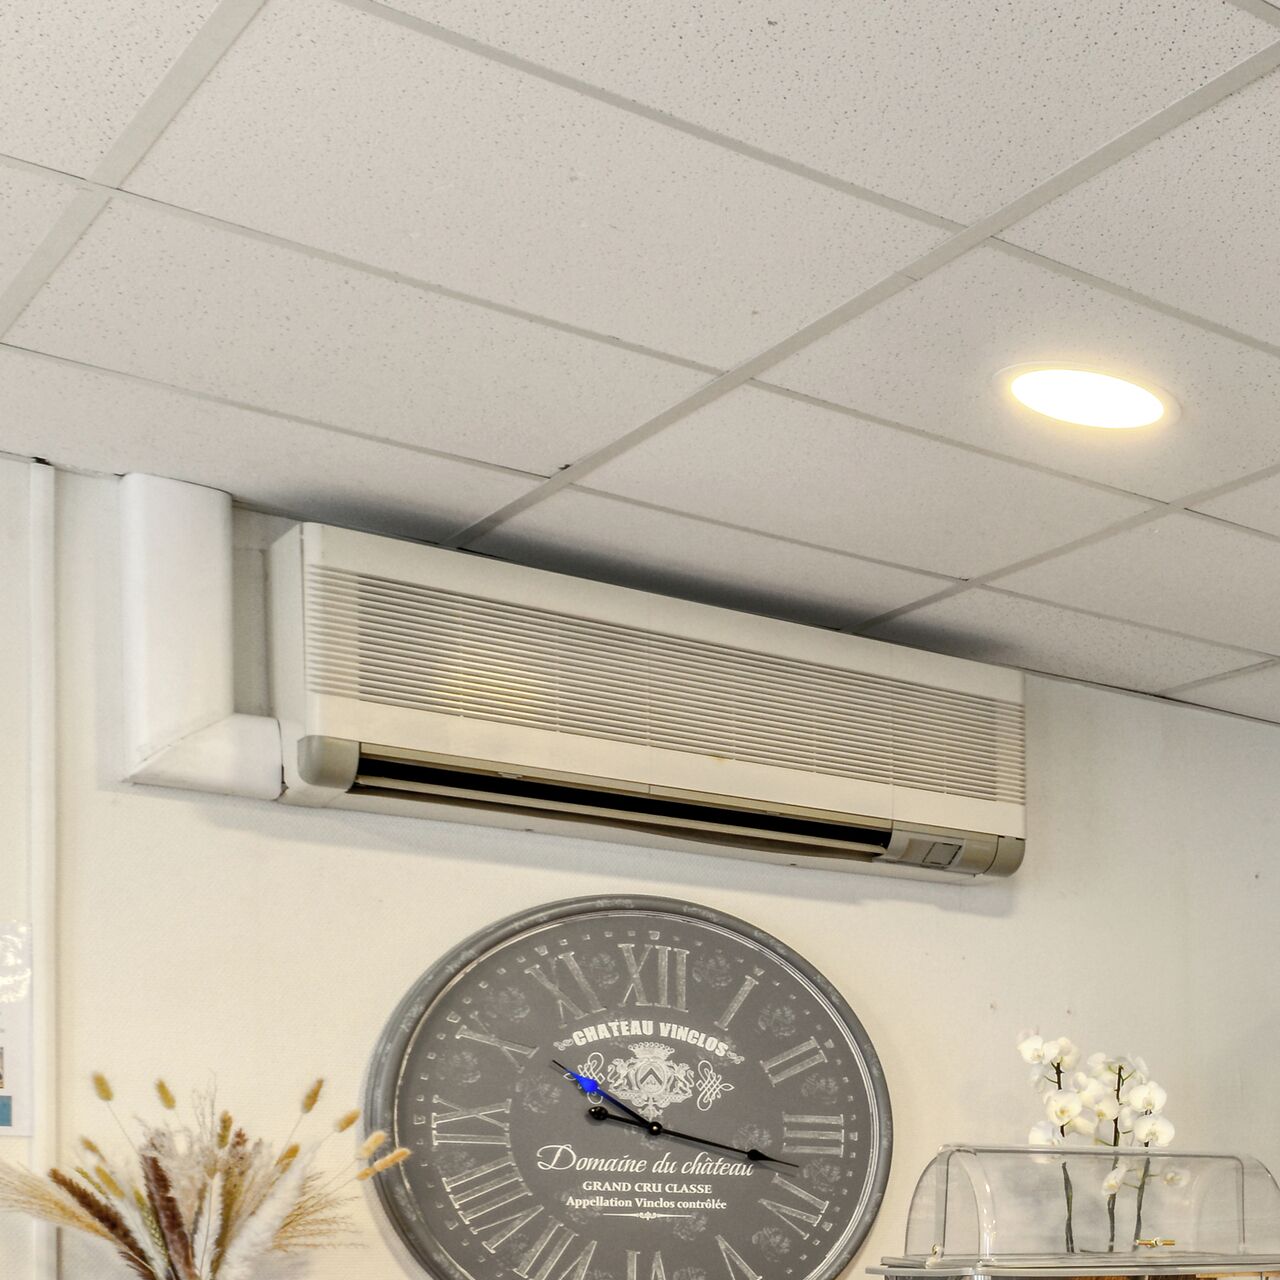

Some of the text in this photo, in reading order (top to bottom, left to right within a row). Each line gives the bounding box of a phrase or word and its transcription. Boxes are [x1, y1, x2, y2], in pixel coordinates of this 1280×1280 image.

[571, 1019, 730, 1058] CHATEAU VINCLOS
[536, 1143, 755, 1178] Domaine du château
[582, 1179, 713, 1195] GRAND CRU CLASSE
[566, 1195, 727, 1211] Appellation Vinclos contrôlée
